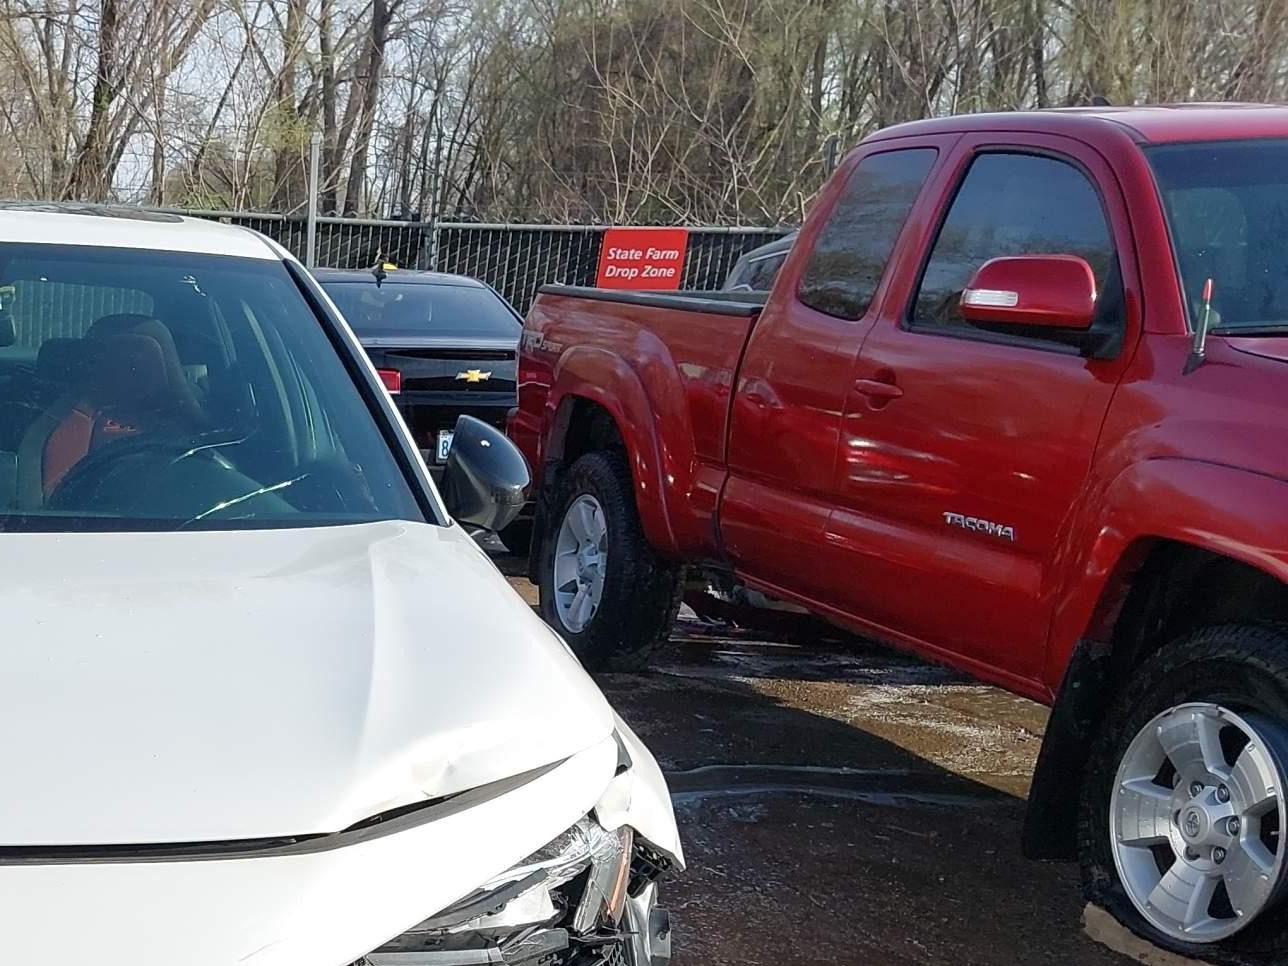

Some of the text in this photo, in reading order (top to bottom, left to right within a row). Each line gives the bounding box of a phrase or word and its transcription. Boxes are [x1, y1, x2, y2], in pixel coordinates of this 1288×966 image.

[607, 247, 680, 260] State Farm
[605, 265, 676, 280] Drop Zone
[942, 511, 1014, 542] TACOMA
